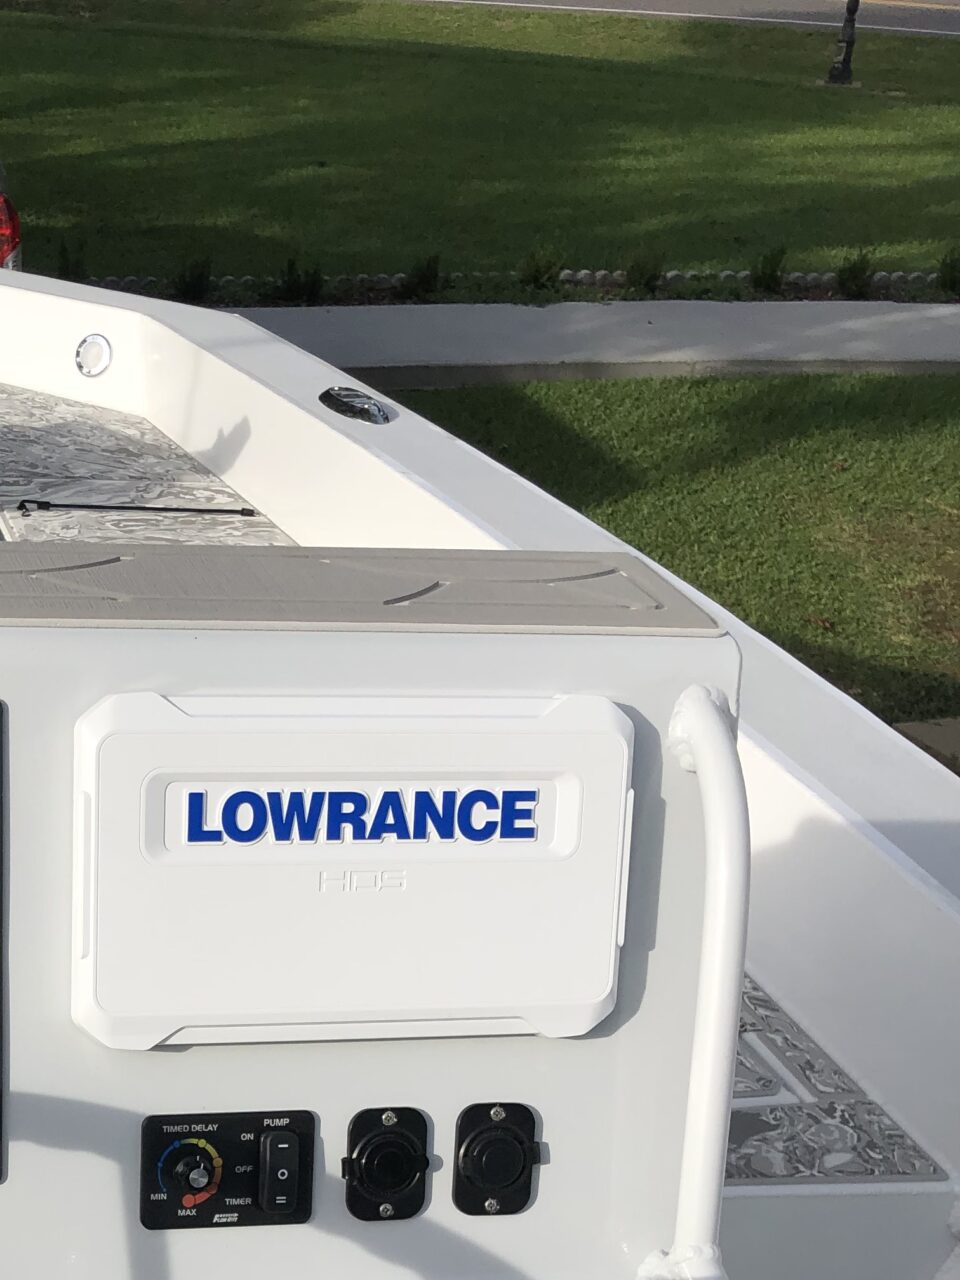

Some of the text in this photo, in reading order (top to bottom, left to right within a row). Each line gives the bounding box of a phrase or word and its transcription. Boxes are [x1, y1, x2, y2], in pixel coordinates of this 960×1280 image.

[187, 788, 540, 843] LOWRANCE
[263, 1118, 290, 1127] PUMP
[162, 1124, 219, 1133] TIMED DELAY
[240, 1133, 254, 1141] ON
[235, 1165, 254, 1173] OFF
[150, 1193, 167, 1201] MIN
[225, 1197, 252, 1205] TIMER
